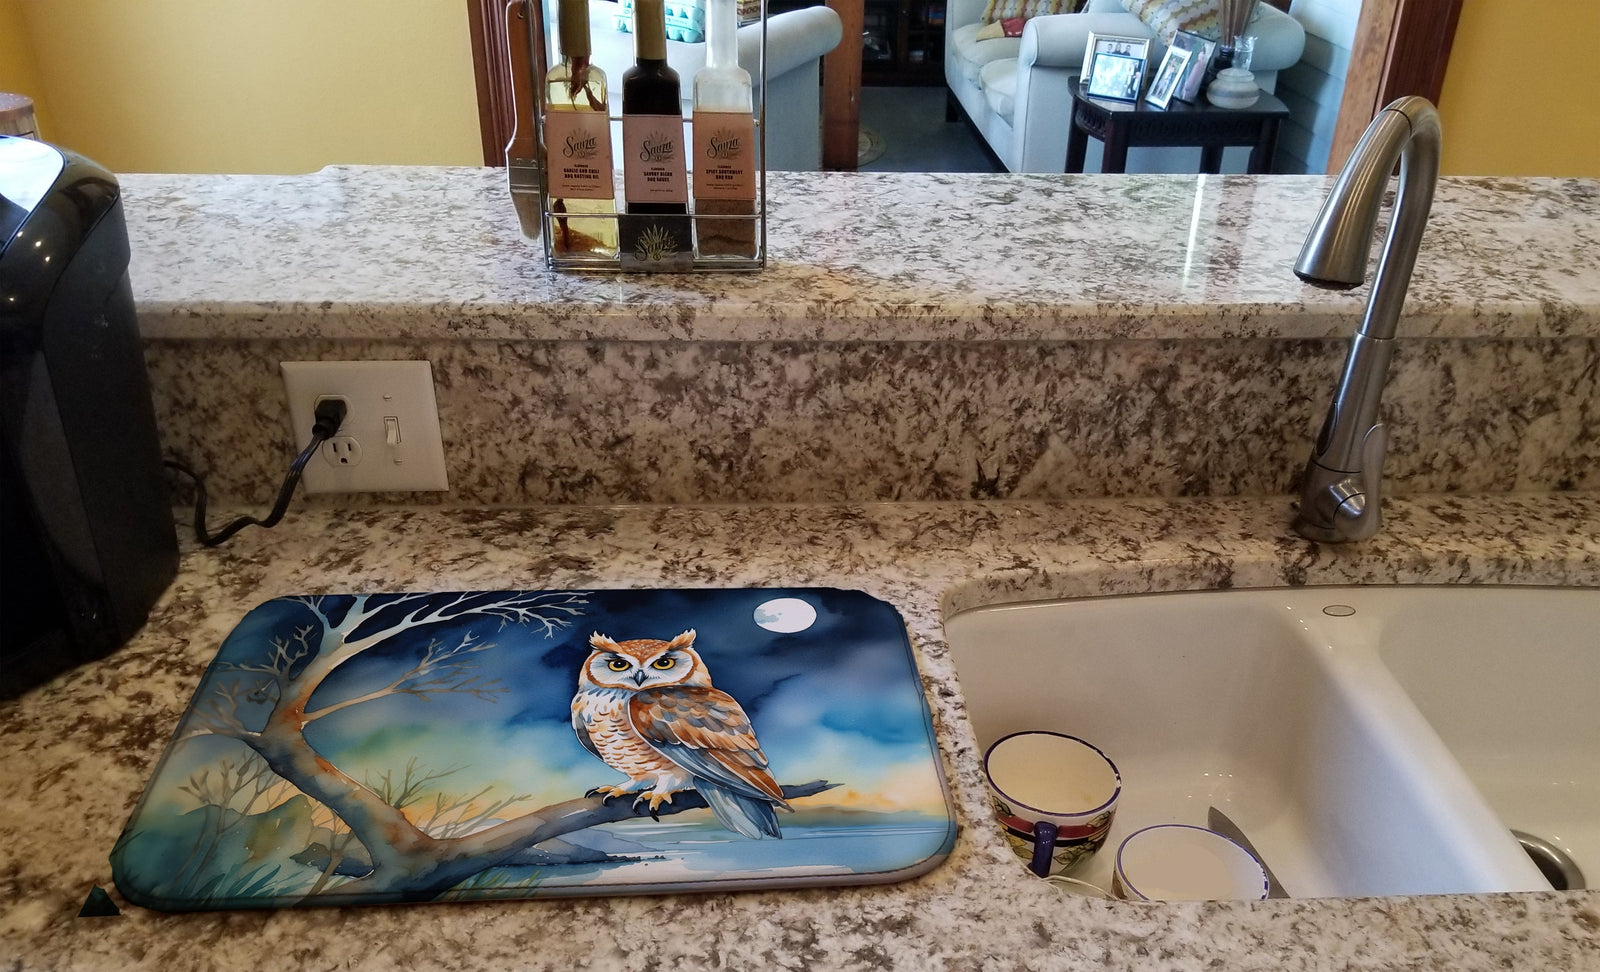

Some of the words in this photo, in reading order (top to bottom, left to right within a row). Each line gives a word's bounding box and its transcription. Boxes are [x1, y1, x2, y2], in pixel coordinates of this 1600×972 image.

[562, 136, 597, 158] Sauza
[640, 140, 674, 161] Sauza
[706, 136, 739, 158] Sauza
